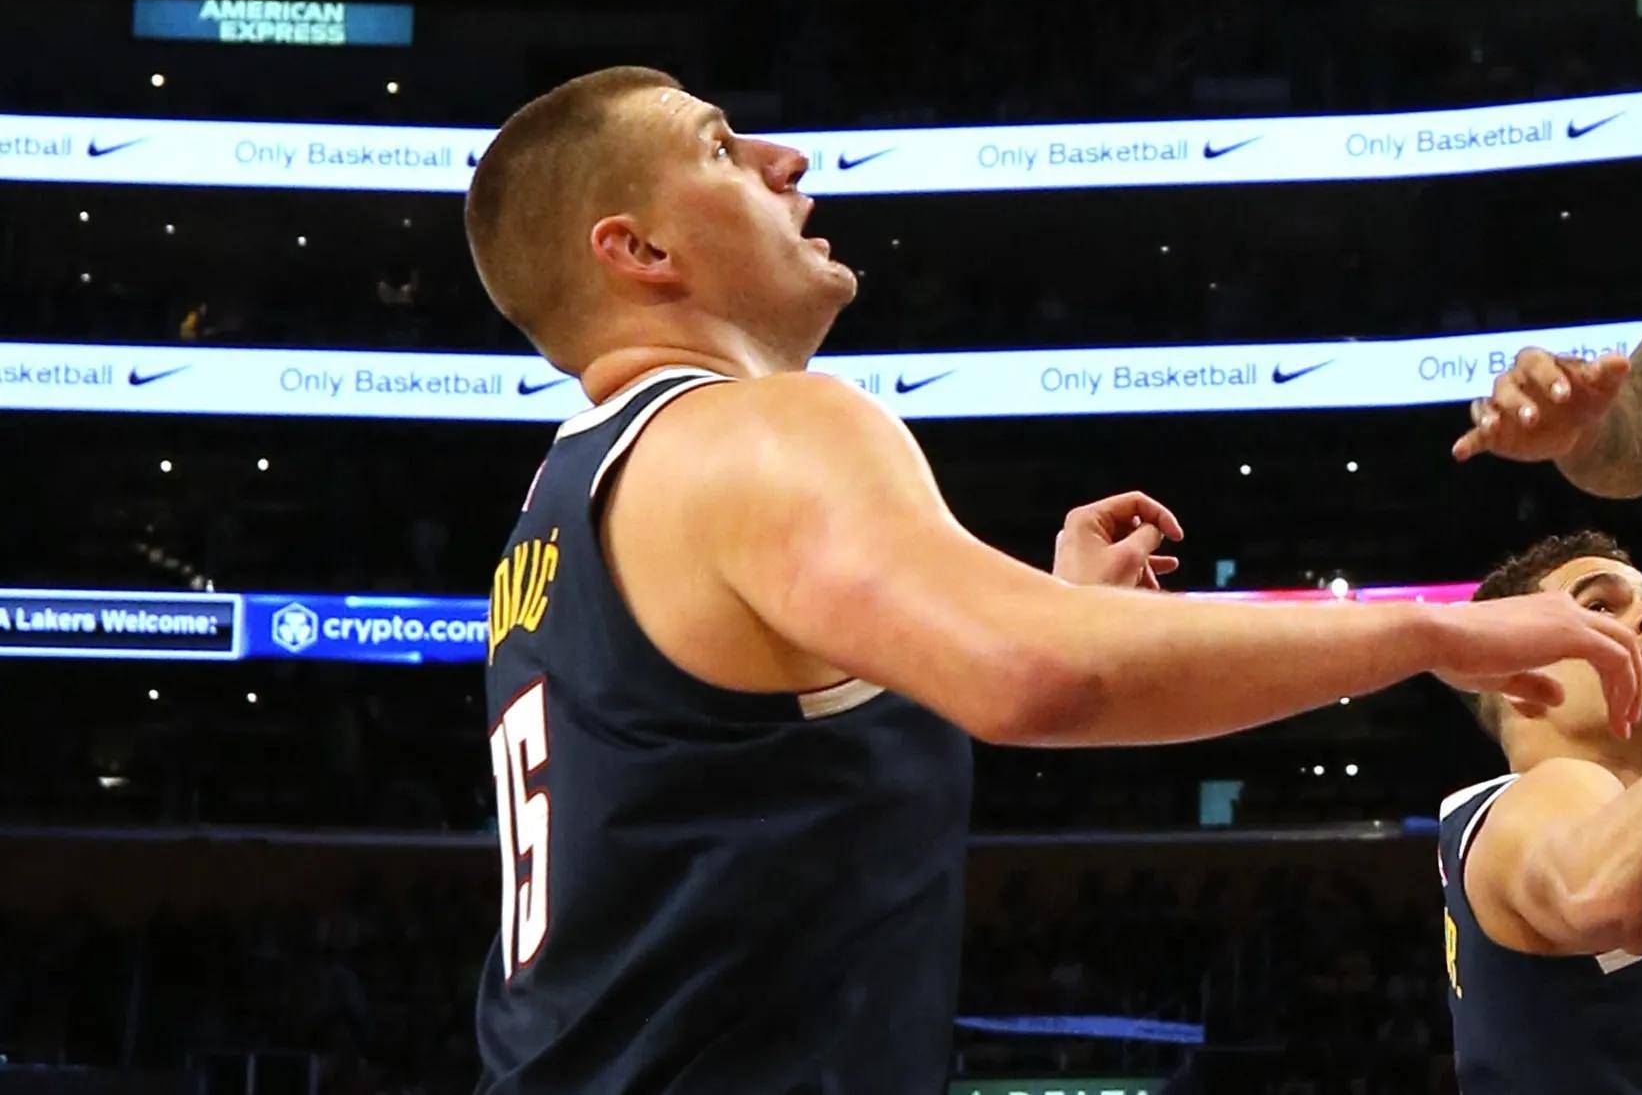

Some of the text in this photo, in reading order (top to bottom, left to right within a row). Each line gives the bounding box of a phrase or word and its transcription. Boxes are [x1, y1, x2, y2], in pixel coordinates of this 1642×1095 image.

[219, 20, 346, 45] EXPRESS
[234, 140, 452, 169] Only Basketball
[1346, 119, 1554, 162] Only Basketball
[978, 139, 1189, 172] Only Basketball
[0, 362, 113, 385] sketball
[278, 367, 503, 396] Only Basketball
[1040, 363, 1258, 395] Only Basketball
[1418, 354, 1478, 383] Only
[15, 607, 97, 632] Lakers
[101, 609, 219, 635] Welcome:
[323, 616, 489, 644] crypto.com
